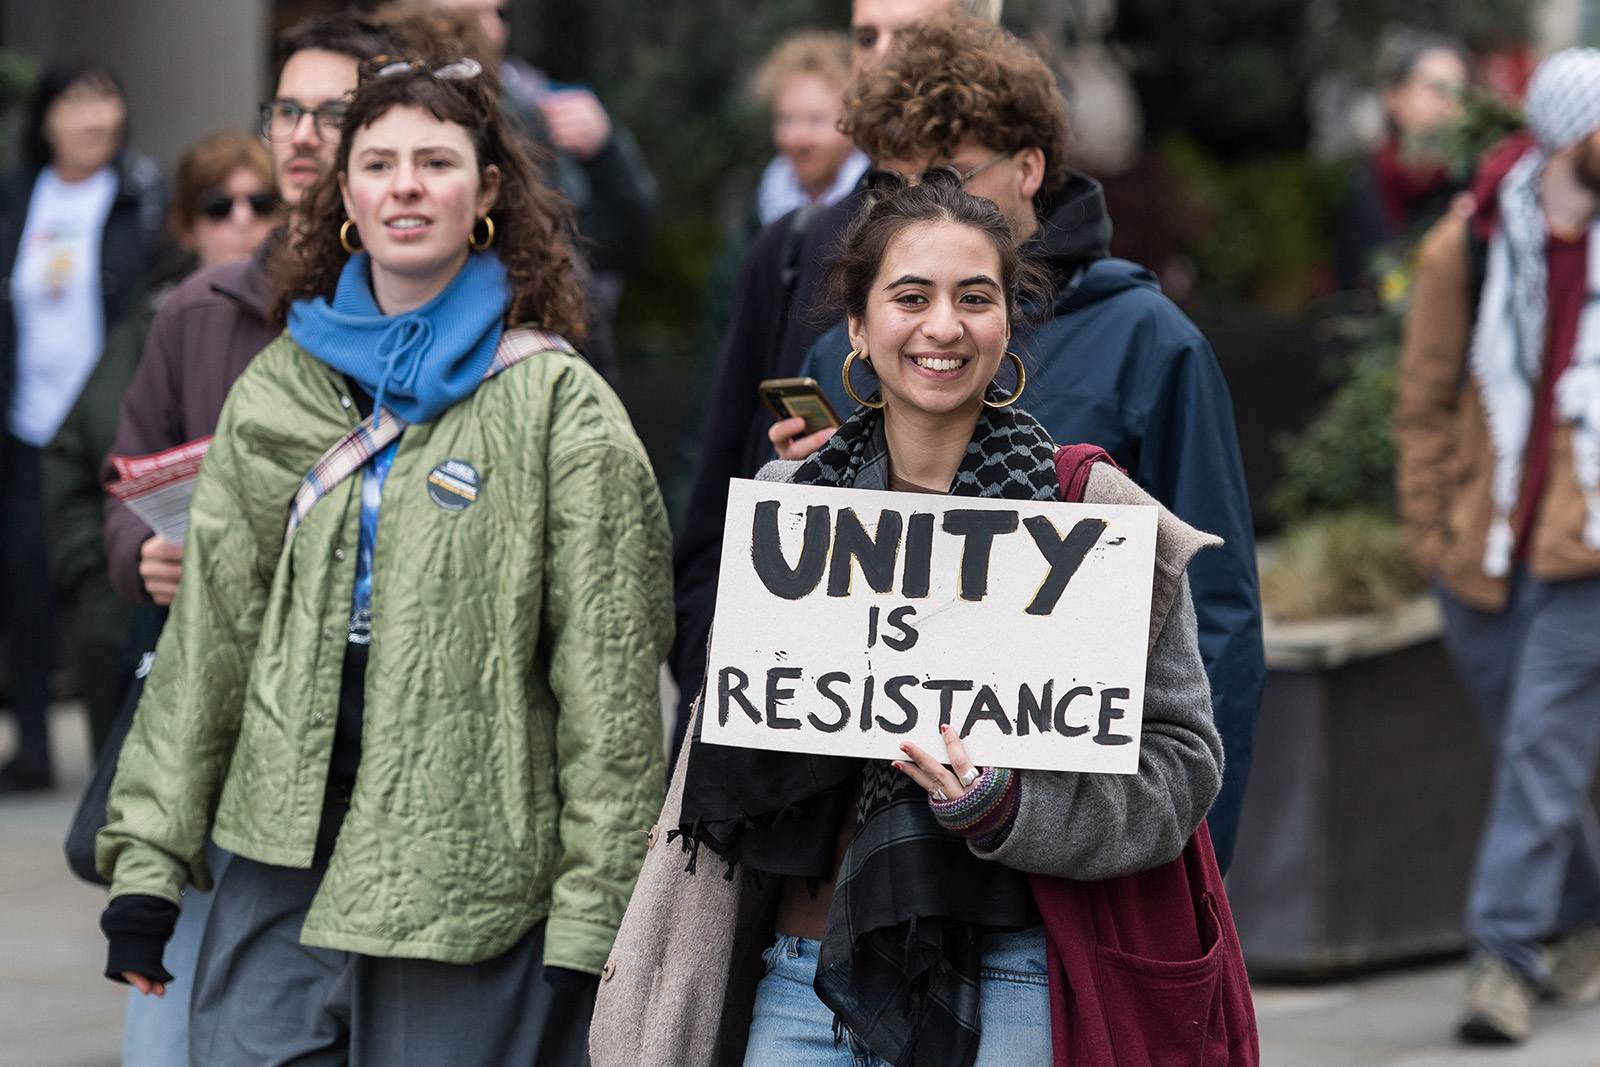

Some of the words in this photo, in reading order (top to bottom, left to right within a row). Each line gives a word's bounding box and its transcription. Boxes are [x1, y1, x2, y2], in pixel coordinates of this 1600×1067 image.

[751, 501, 1110, 616] UNITY
[868, 605, 919, 651] IS
[718, 667, 1133, 746] RESISTANCE
